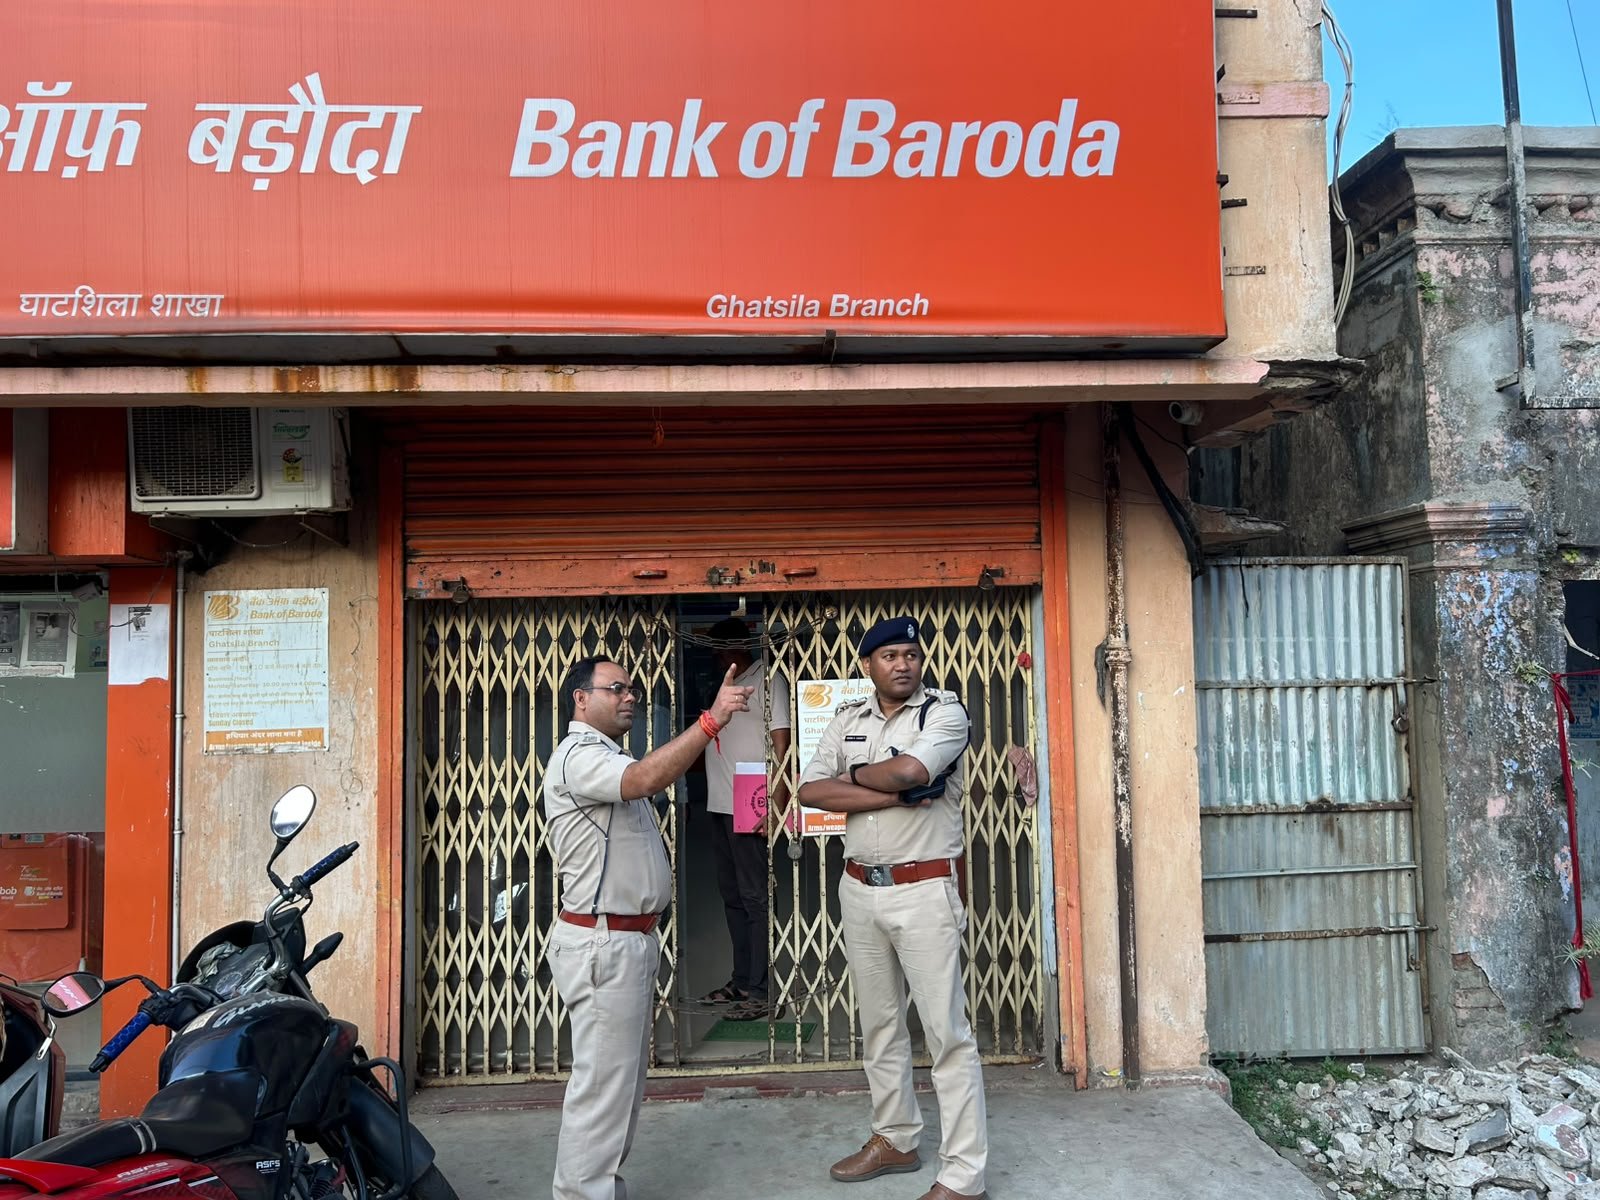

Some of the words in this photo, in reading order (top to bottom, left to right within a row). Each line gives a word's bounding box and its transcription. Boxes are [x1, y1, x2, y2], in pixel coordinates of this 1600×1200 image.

[188, 72, 422, 191] बड़ौदा
[509, 97, 727, 179] Bank
[738, 97, 825, 179] of
[832, 97, 1121, 179] Baroda
[19, 284, 142, 318] घाटशिला
[150, 293, 225, 319] शाखा
[706, 293, 821, 319] Ghatsila
[829, 293, 930, 318] Branch
[250, 610, 274, 620] Bank
[277, 609, 287, 620] of
[287, 608, 323, 619] Baroda
[247, 640, 280, 648] Branch
